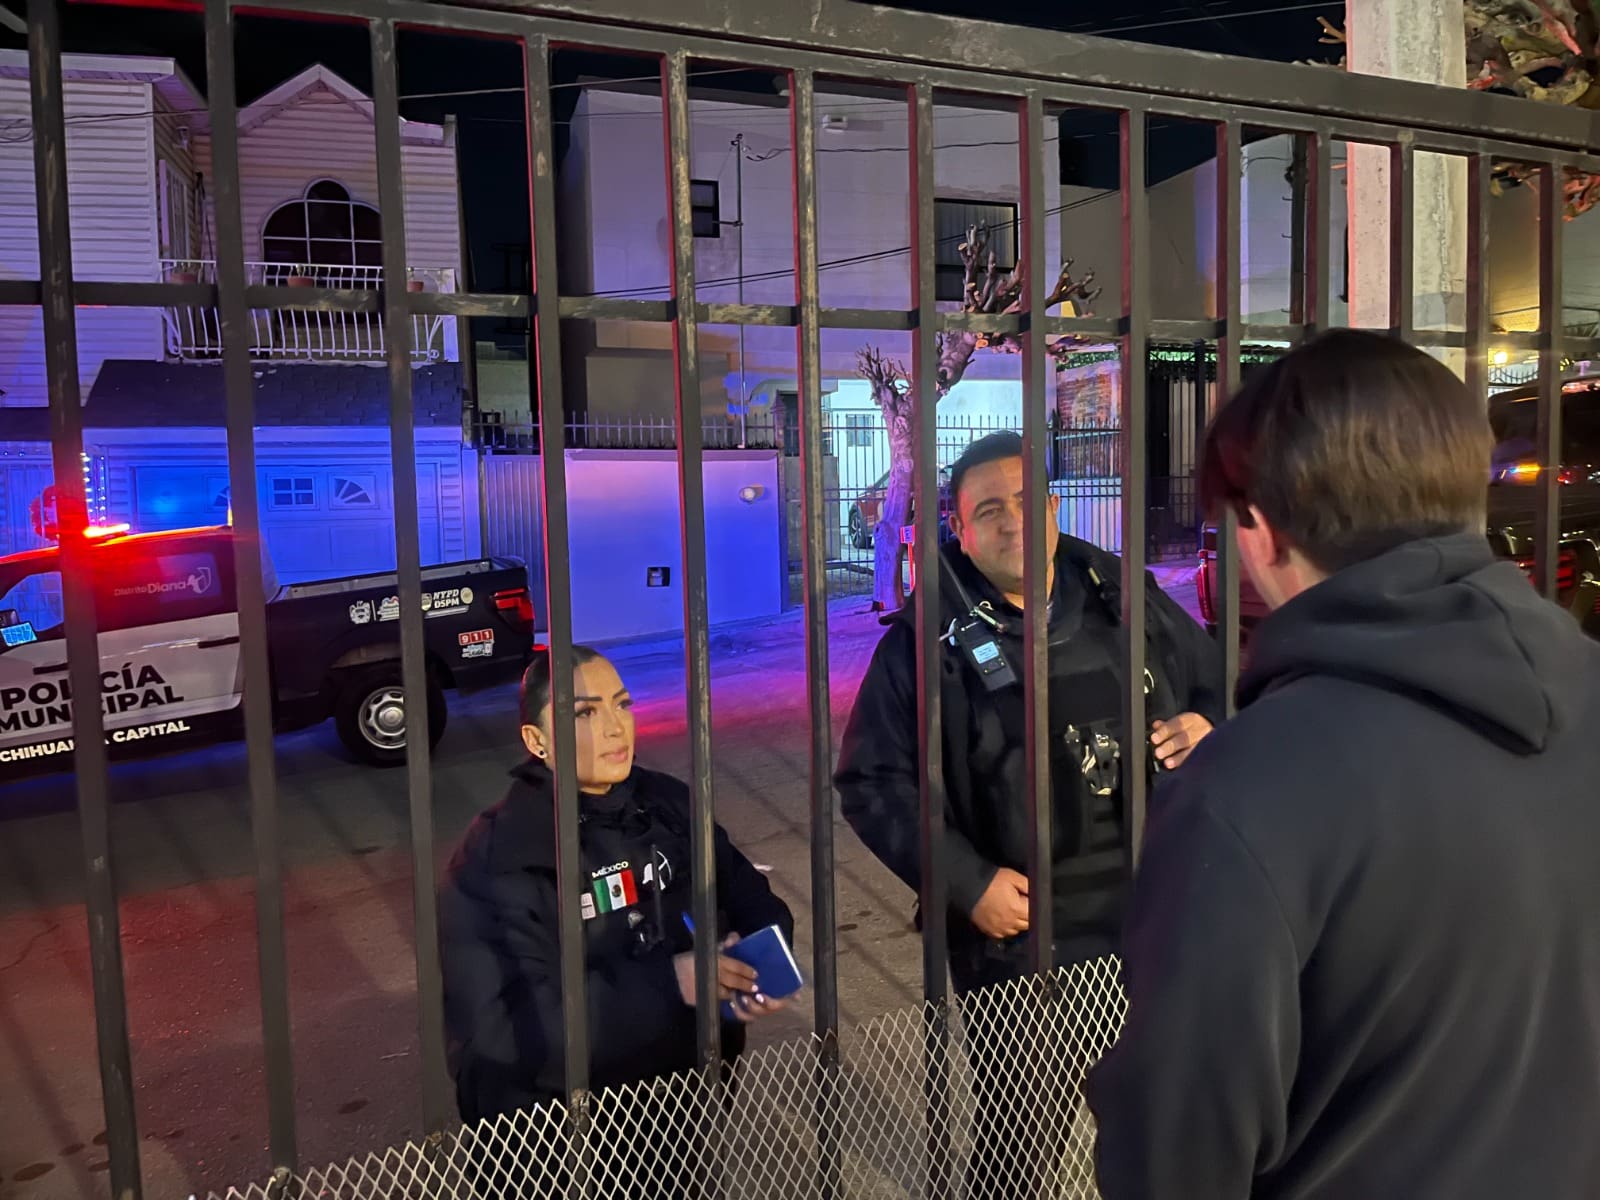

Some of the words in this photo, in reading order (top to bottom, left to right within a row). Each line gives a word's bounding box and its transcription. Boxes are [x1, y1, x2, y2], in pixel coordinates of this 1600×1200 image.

[147, 581, 186, 594] Diana
[433, 588, 460, 600] NYPD
[434, 597, 460, 609] DSPM
[461, 630, 491, 644] 911
[0, 662, 166, 711] POLCÍA
[0, 685, 184, 733] MUNIPAL
[0, 738, 110, 763] CHIHUA
[112, 720, 191, 743] CAPITAL
